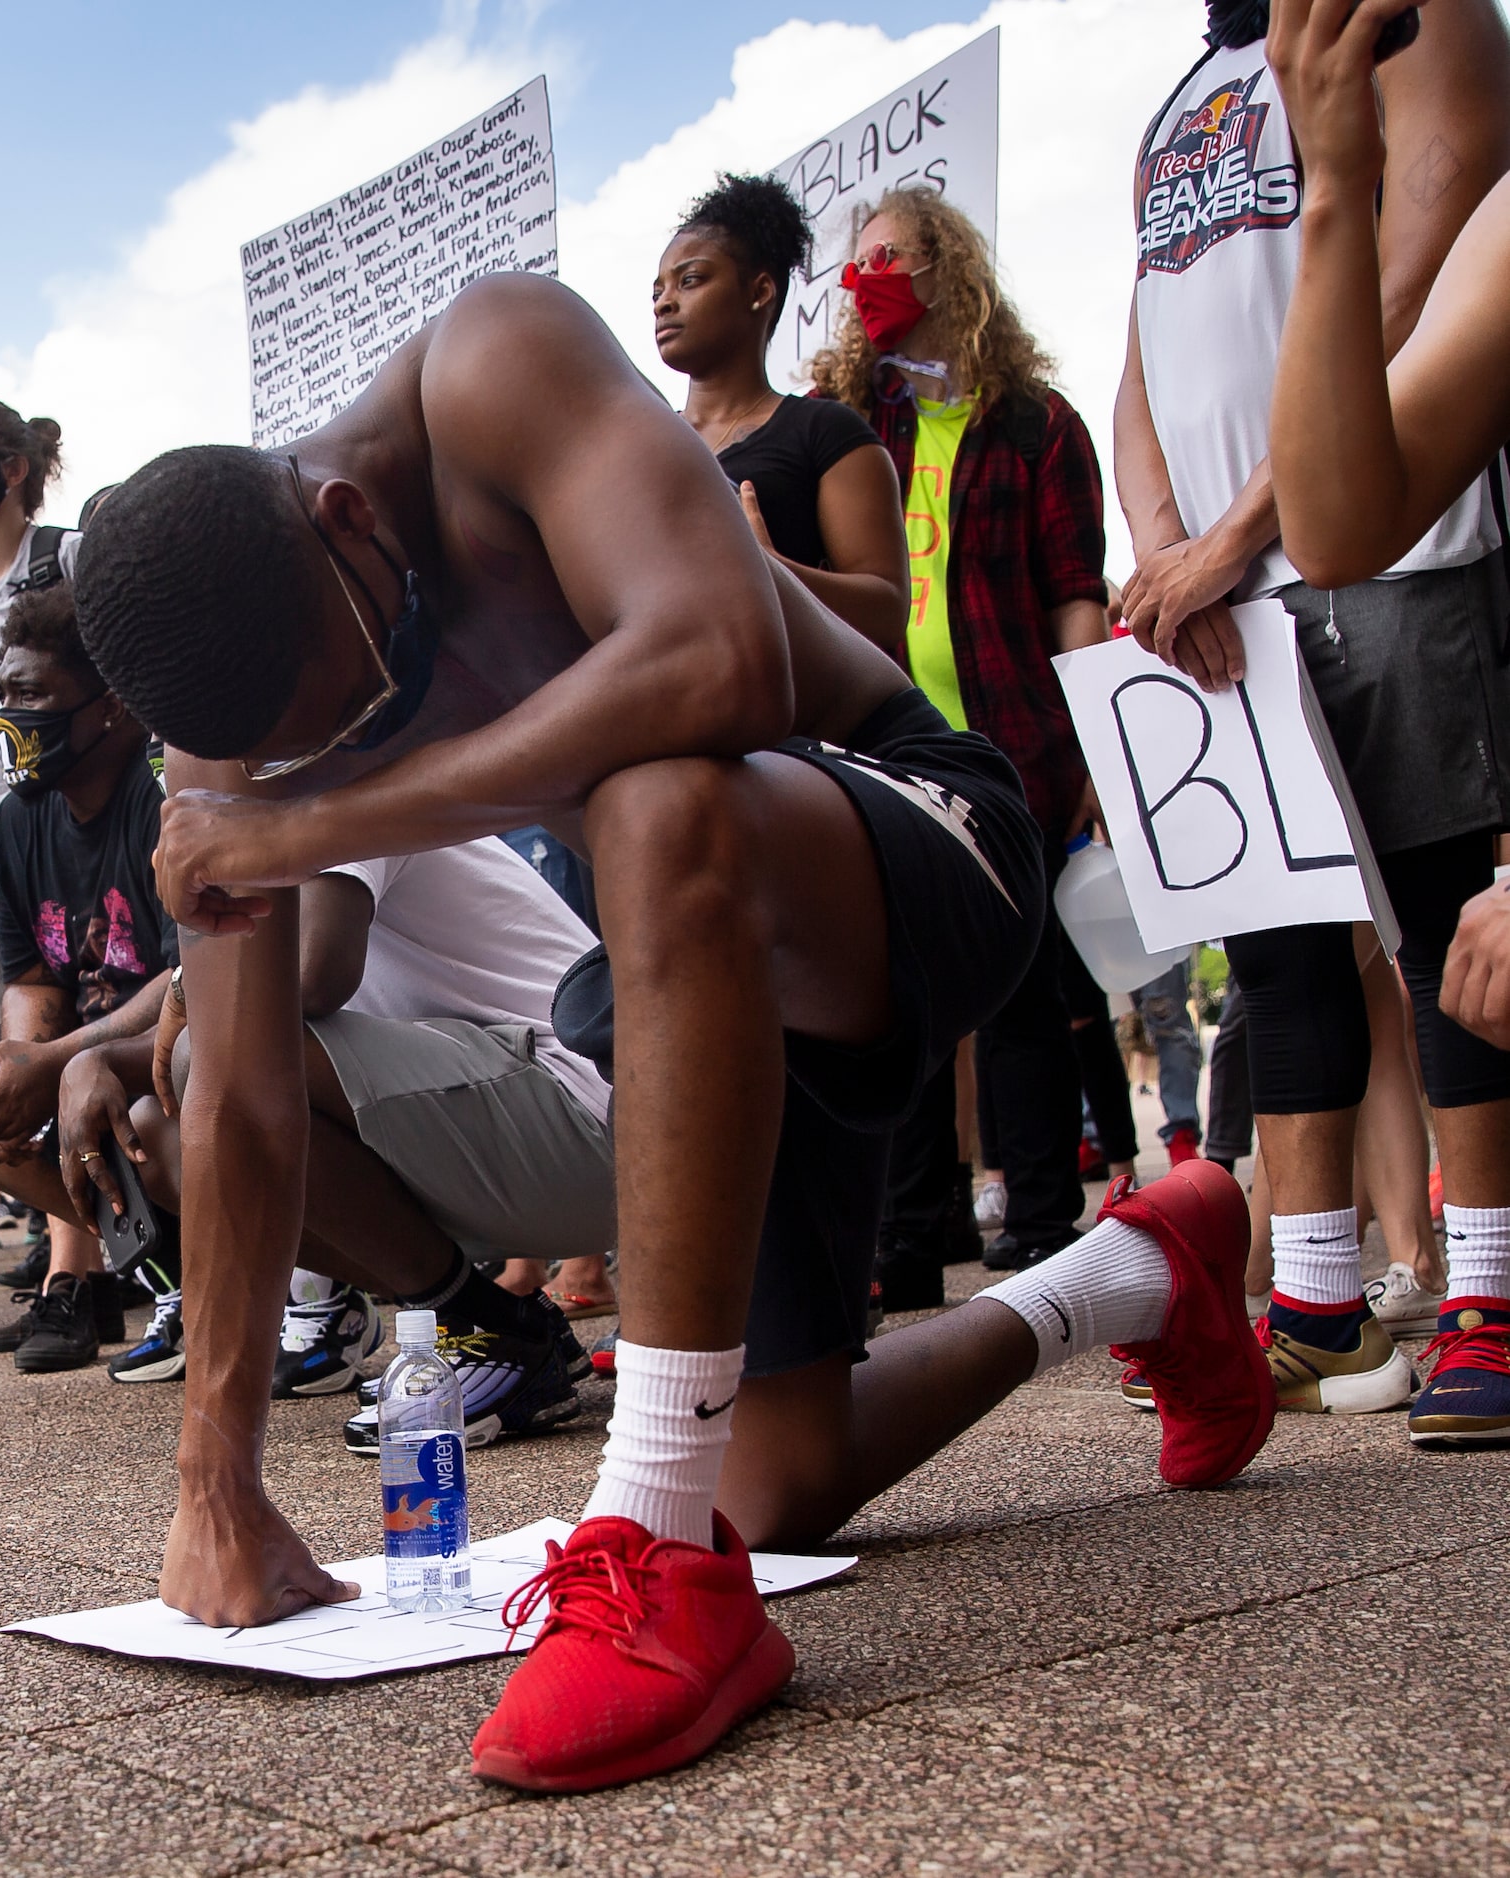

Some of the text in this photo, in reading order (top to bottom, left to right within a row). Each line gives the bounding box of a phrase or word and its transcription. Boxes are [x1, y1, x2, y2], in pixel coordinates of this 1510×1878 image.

[788, 79, 949, 221] BLACK
[1153, 137, 1211, 185] Red
[242, 237, 280, 267] Alton
[340, 173, 393, 213] Philando
[441, 128, 477, 157] Oscar
[245, 255, 286, 287] Sandra
[336, 198, 387, 236] Freddie
[434, 160, 461, 184] Sam
[248, 272, 290, 307] Phillip
[448, 161, 494, 192] Kimani
[398, 199, 455, 243] Kenneth
[252, 333, 279, 354] Eric
[328, 283, 359, 308] Tony
[428, 209, 481, 246] Tanisha
[253, 348, 281, 370] Mike
[413, 247, 446, 278] Ezell
[486, 209, 517, 234] Eric
[409, 260, 461, 298] Trayvon
[514, 209, 556, 238] Tamir
[298, 363, 349, 402] Eleanor
[300, 345, 342, 379] Walter
[386, 305, 416, 331] Sean
[283, 415, 322, 443] Omar
[305, 390, 338, 415] John
